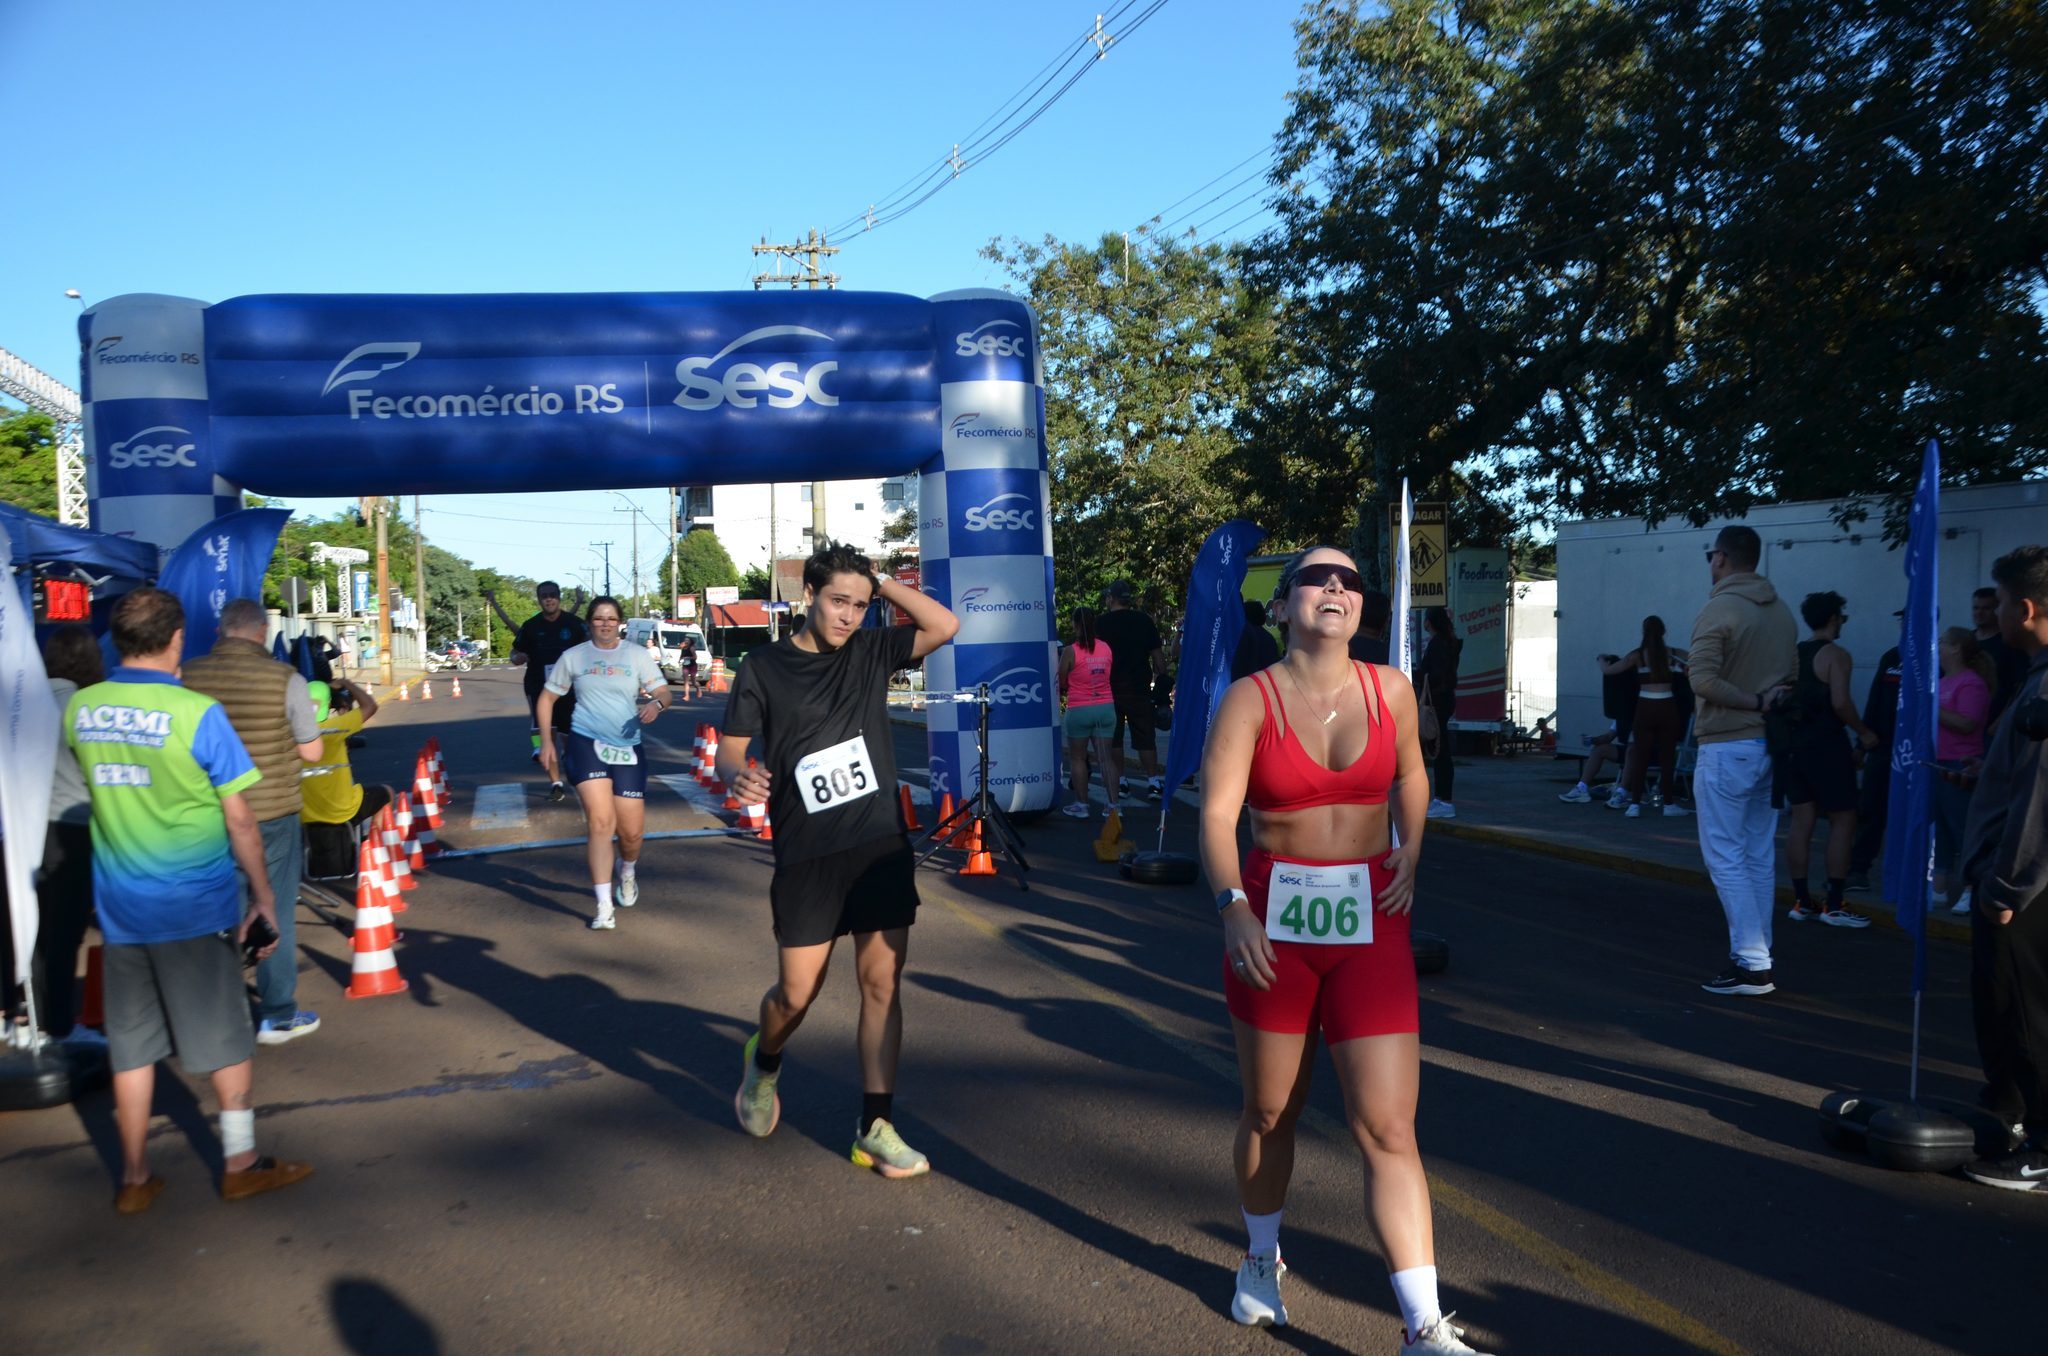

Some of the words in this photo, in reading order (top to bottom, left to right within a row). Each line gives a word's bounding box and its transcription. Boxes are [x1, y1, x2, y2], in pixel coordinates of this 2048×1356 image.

[956, 332, 1025, 358] Sesc
[100, 352, 177, 365] Fecomércio
[181, 353, 200, 365] RS
[672, 356, 840, 411] Sesc
[348, 385, 564, 419] Fecomércio
[575, 383, 624, 414] RS
[956, 426, 1022, 439] Fecomércio
[1025, 427, 1036, 438] RS
[109, 442, 197, 469] Sesc
[964, 506, 1035, 532] Sesc
[1394, 511, 1442, 521] DAGAR
[1458, 562, 1504, 580] FoodTruck
[1410, 583, 1444, 597] EVADA
[966, 600, 1032, 613] Fecomércio
[1034, 600, 1045, 611] RS
[1459, 608, 1486, 622] TUDO
[1467, 618, 1501, 635] ESPETO
[75, 704, 174, 736] ACEMI
[811, 760, 866, 804] 805
[975, 774, 1040, 786] Fcomércio
[1042, 772, 1053, 782] RS
[1279, 874, 1302, 886] Sesc
[1279, 894, 1359, 937] 406
